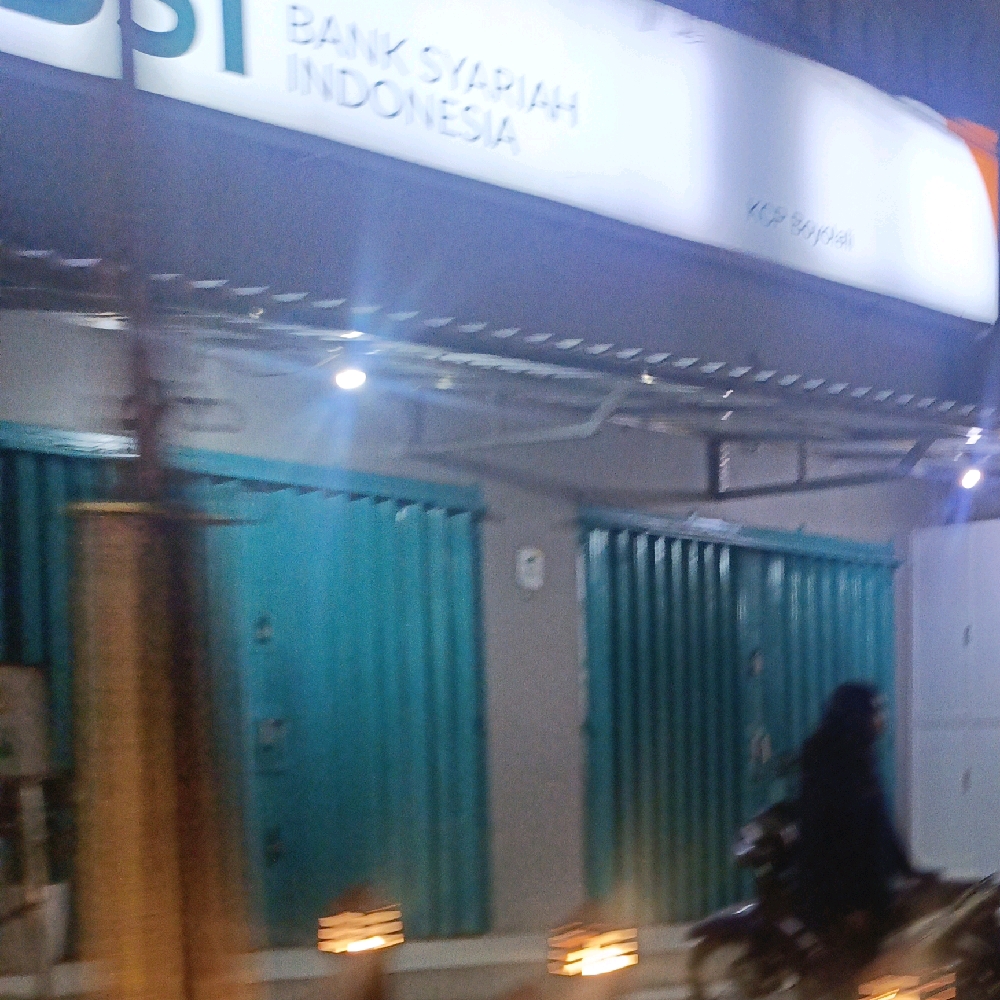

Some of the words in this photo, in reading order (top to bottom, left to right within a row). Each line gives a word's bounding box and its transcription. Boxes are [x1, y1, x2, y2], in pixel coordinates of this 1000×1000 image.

[286, 53, 521, 156] INDONESIA
[287, 4, 410, 76] BANK
[419, 45, 579, 128] SYARIAH
